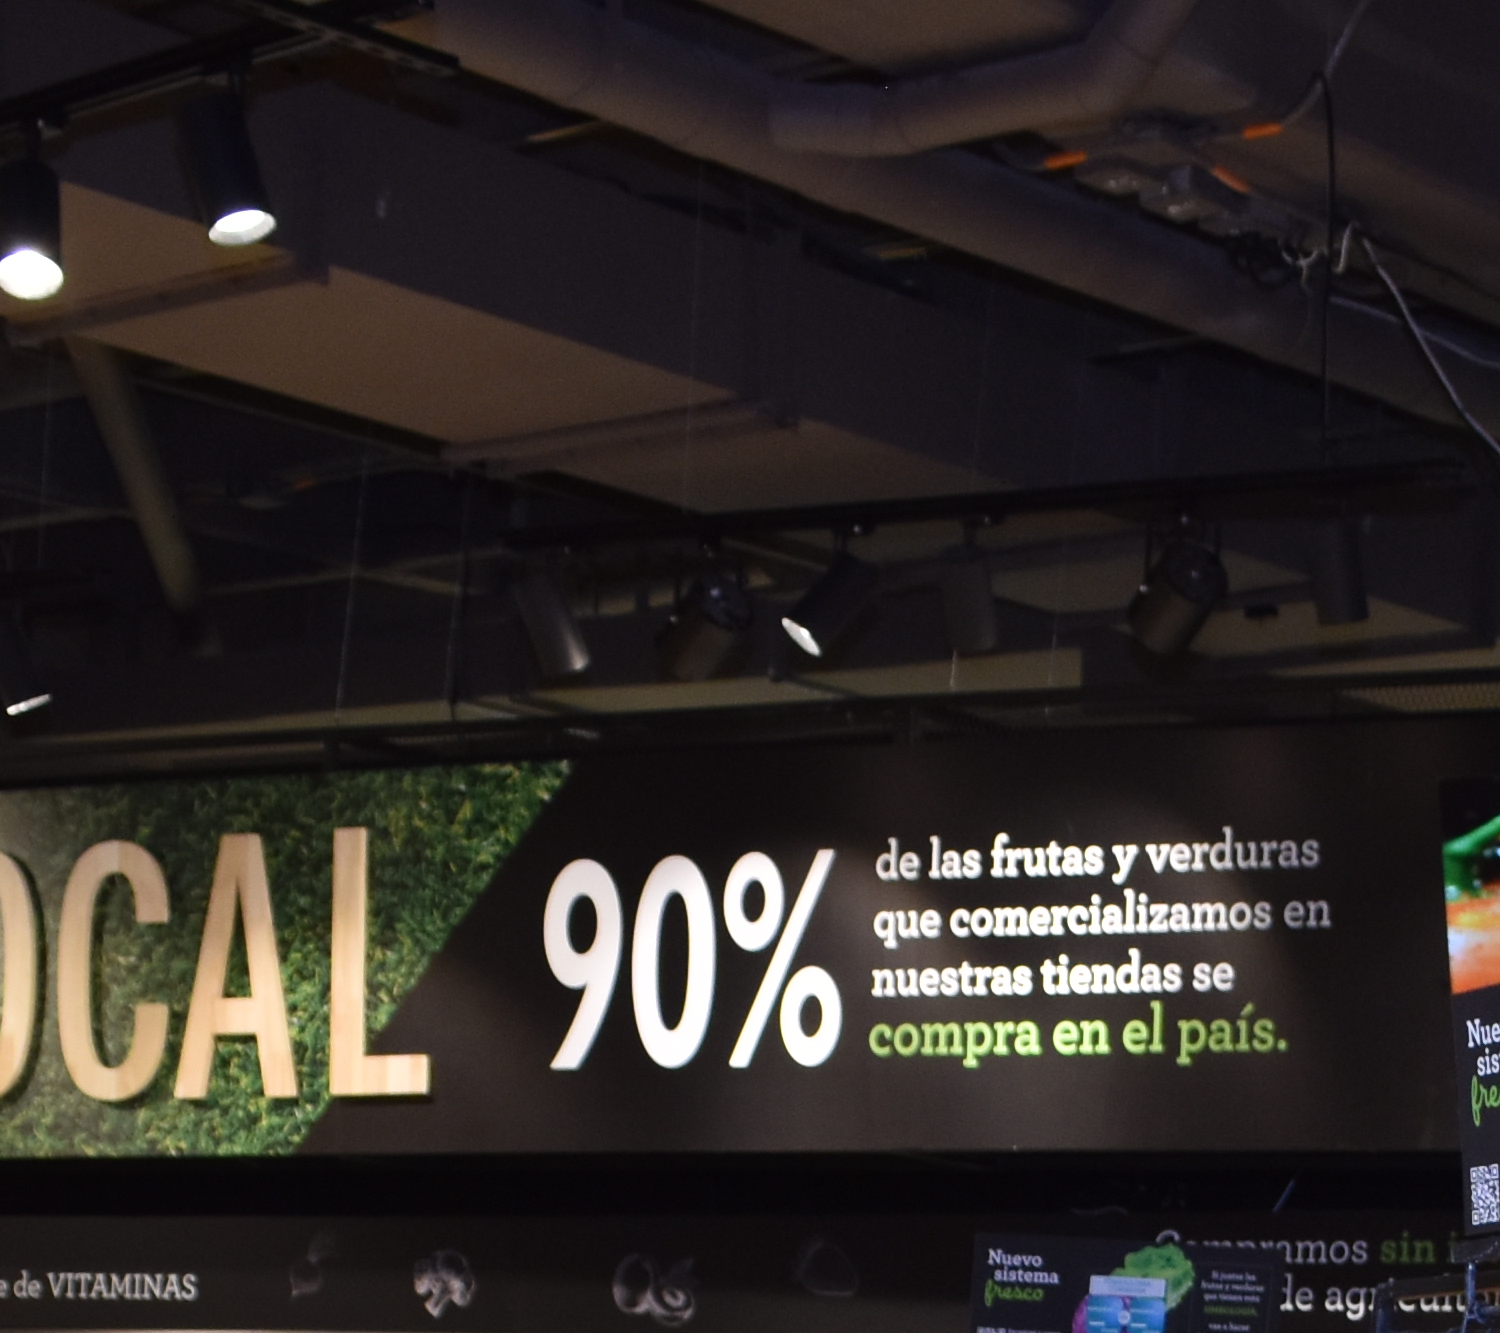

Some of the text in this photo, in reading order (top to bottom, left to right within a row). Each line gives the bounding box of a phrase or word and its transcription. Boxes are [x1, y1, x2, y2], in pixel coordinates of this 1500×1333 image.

[875, 827, 1321, 887] de las frutas y verduras
[873, 890, 1331, 950] que comercializamos en
[542, 849, 843, 1072] 90%
[870, 948, 1235, 1000] nuestras tiendas se
[868, 1002, 1289, 1070] compra en el país.
[987, 1247, 1044, 1268] Nuevo
[993, 1265, 1060, 1285] sistema
[12, 1271, 42, 1300] de
[46, 1270, 199, 1303] VITAMINAS
